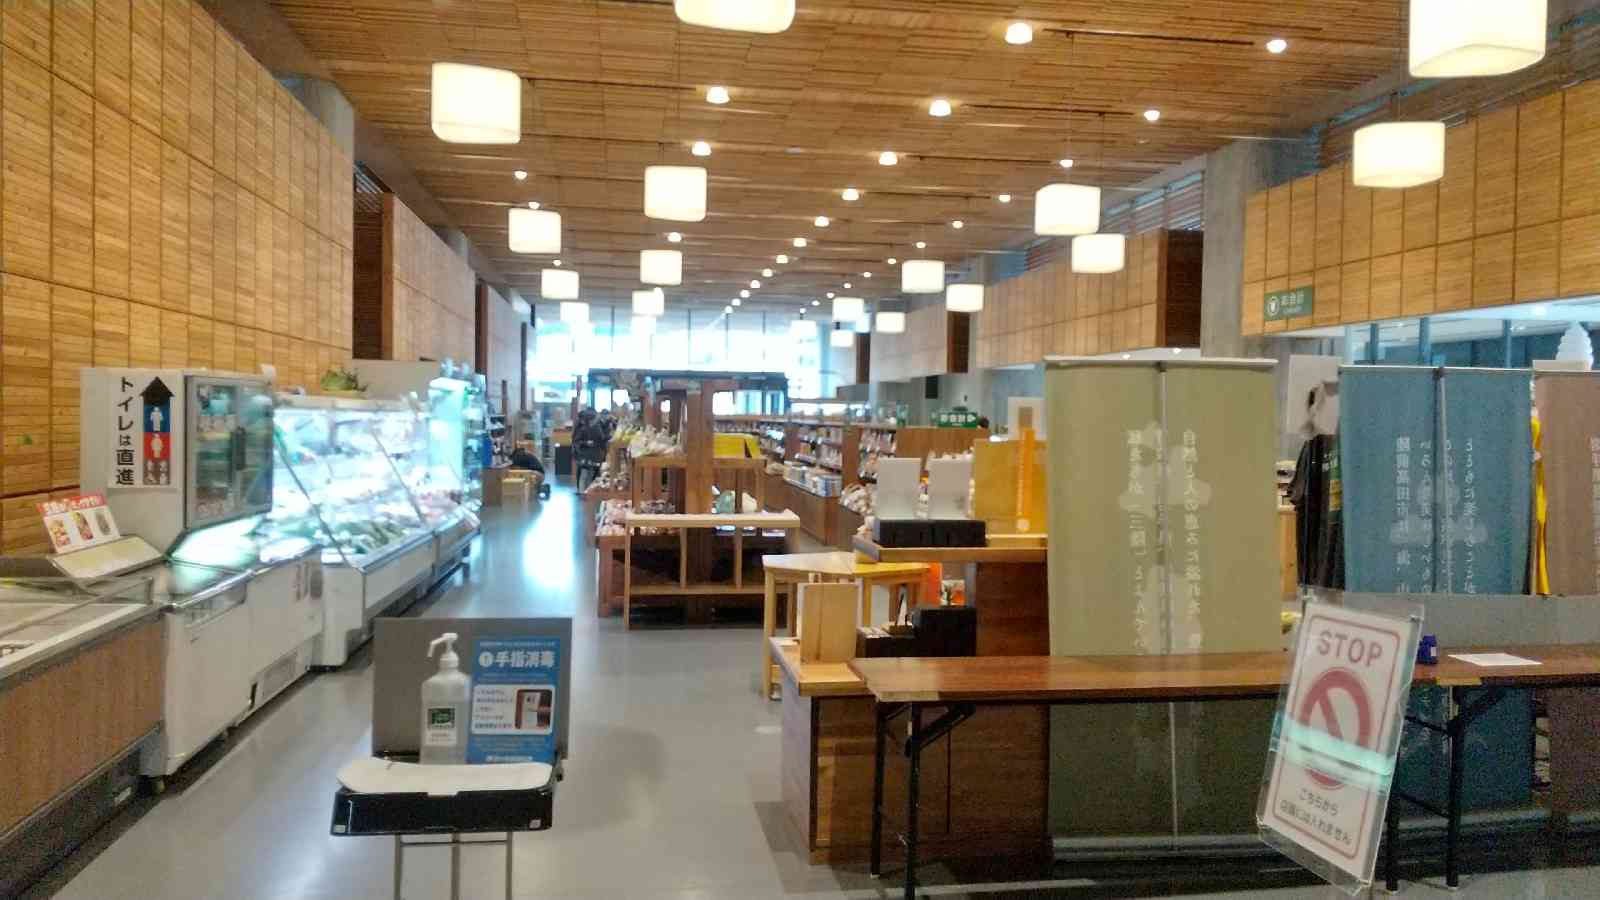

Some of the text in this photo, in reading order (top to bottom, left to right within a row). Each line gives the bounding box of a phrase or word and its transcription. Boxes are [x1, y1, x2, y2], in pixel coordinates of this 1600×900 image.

[116, 376, 135, 485] トイレは直進
[1317, 629, 1383, 666] STOP
